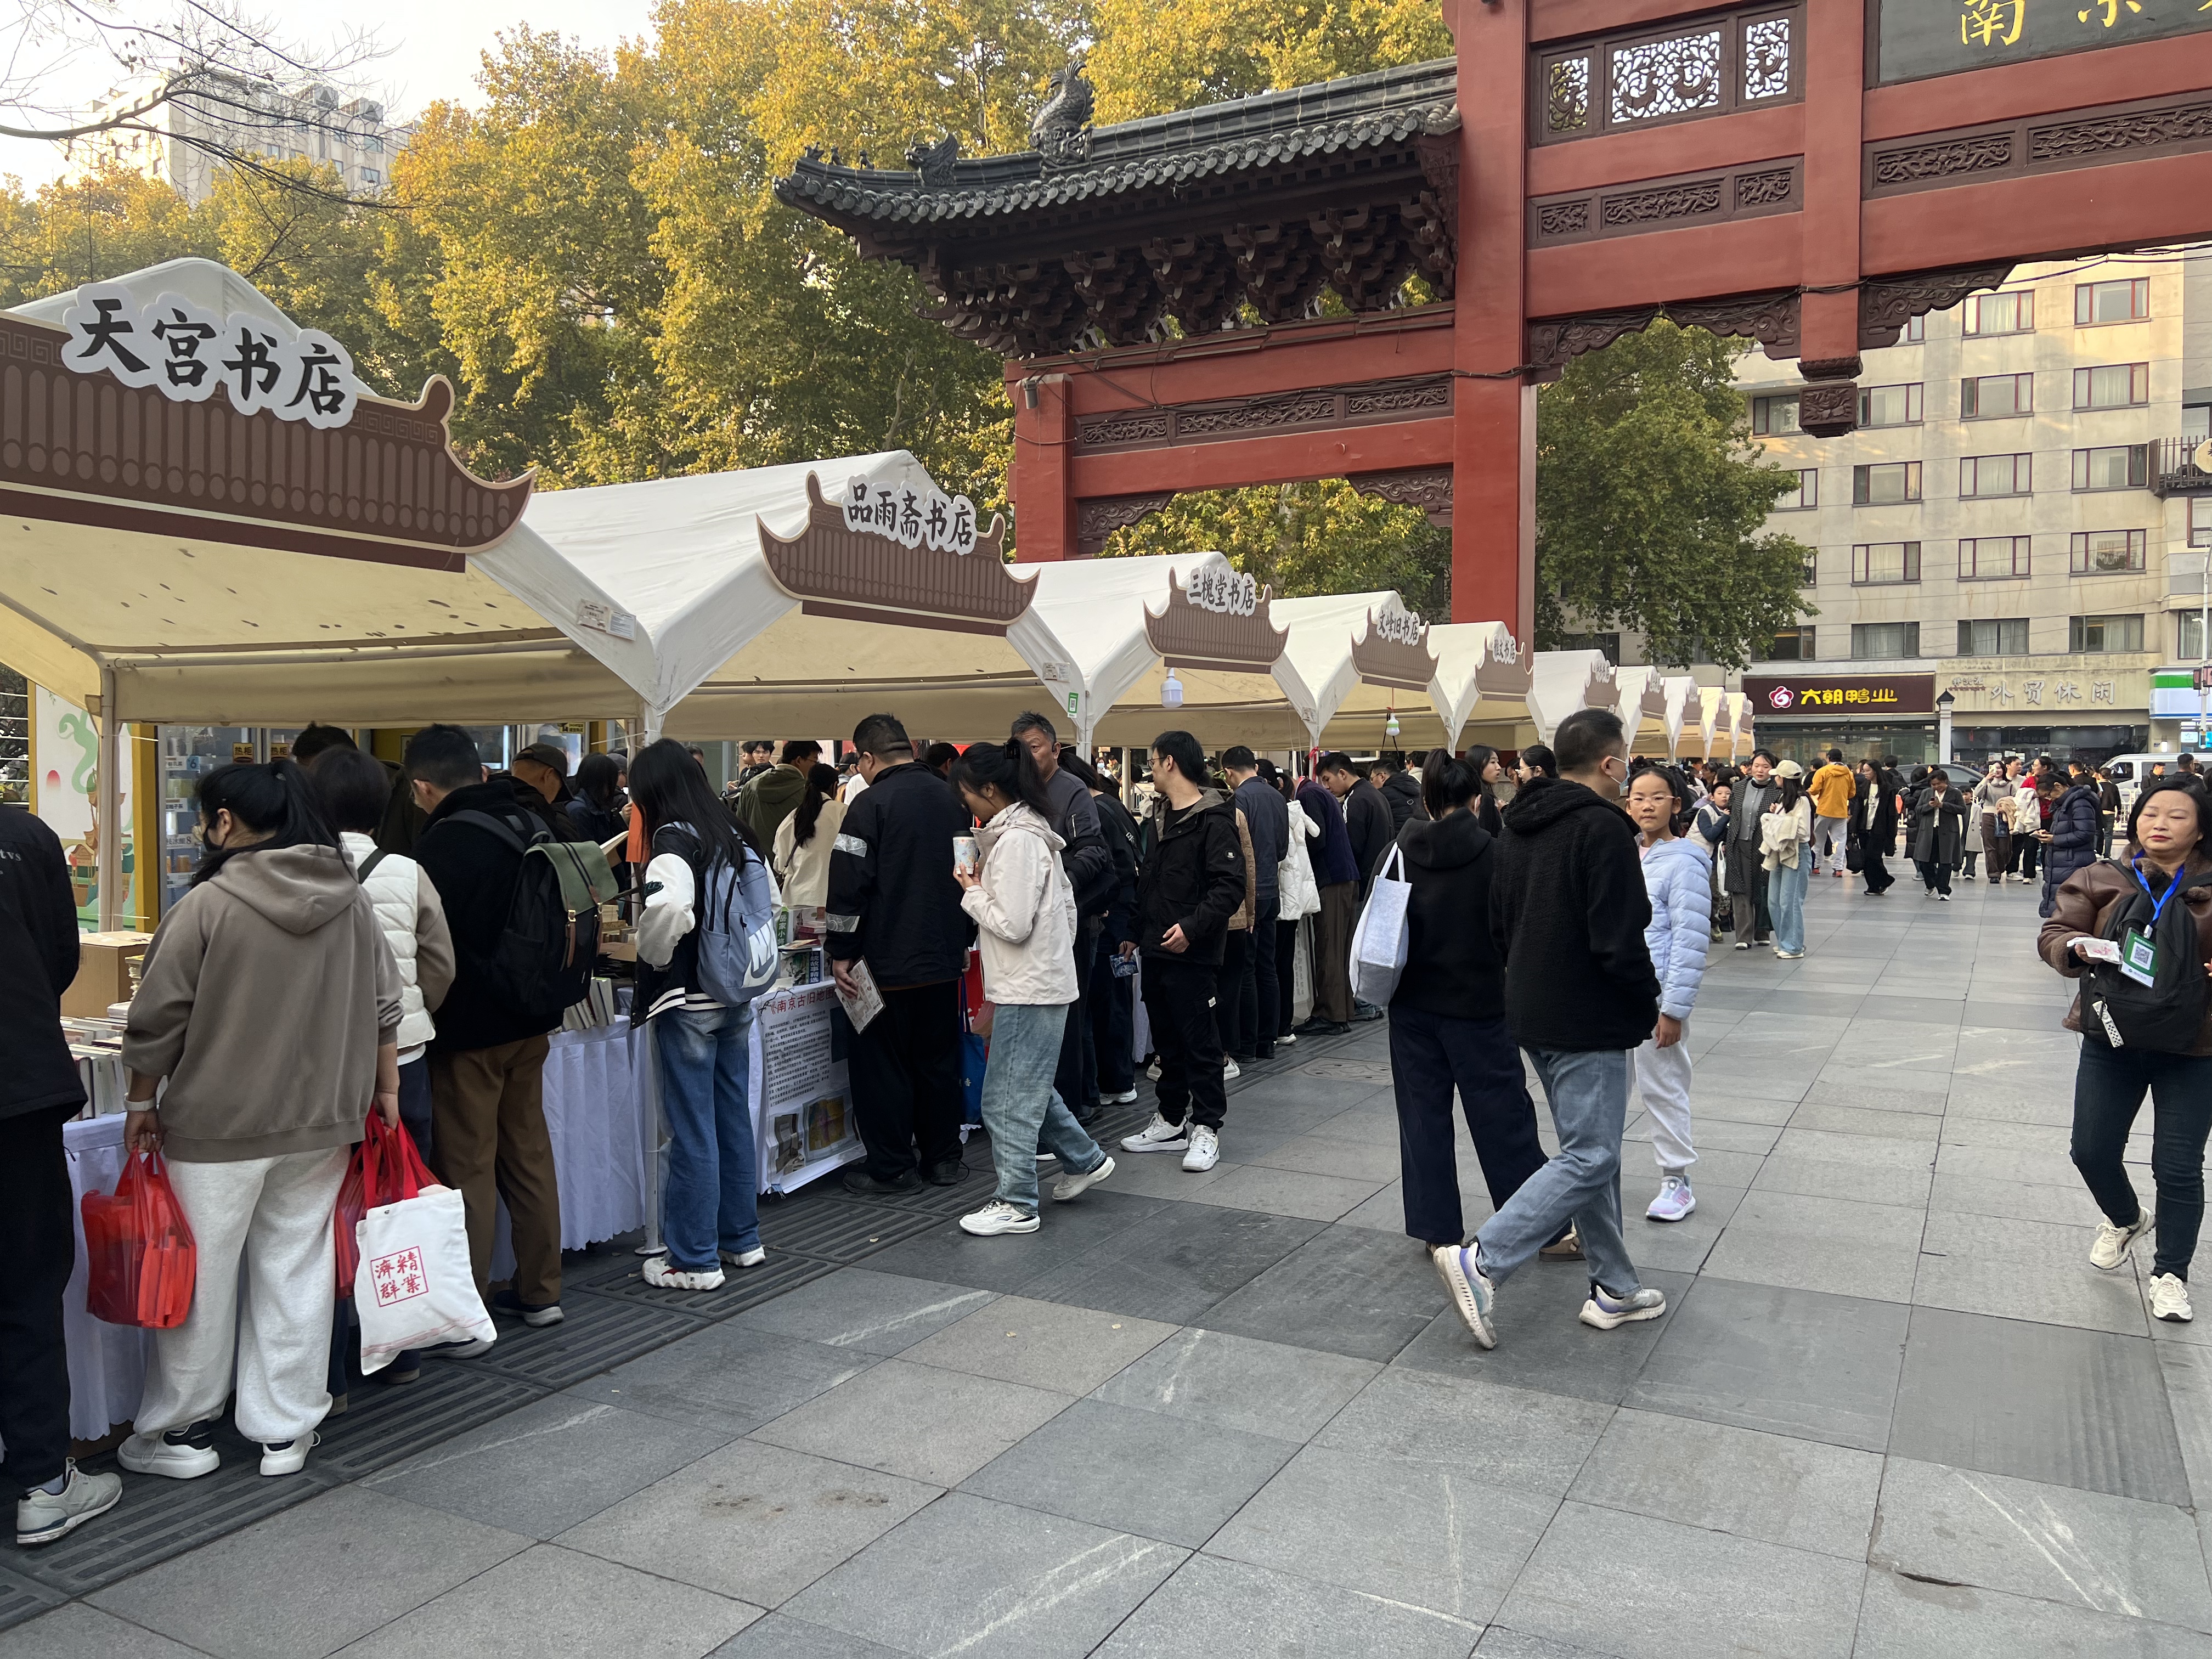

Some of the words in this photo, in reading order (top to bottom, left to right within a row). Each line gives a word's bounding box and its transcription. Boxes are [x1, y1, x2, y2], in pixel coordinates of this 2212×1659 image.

[77, 298, 346, 415] 天宫书店
[847, 483, 973, 548] 品雨斋书店
[1189, 572, 1254, 611] 三槐堂书店
[1378, 609, 1419, 641] 文峰旧书店
[1990, 680, 2117, 706] 外贸休闲
[777, 913, 787, 945] 岳家小将
[770, 986, 837, 1015] 《南京古旧地图
